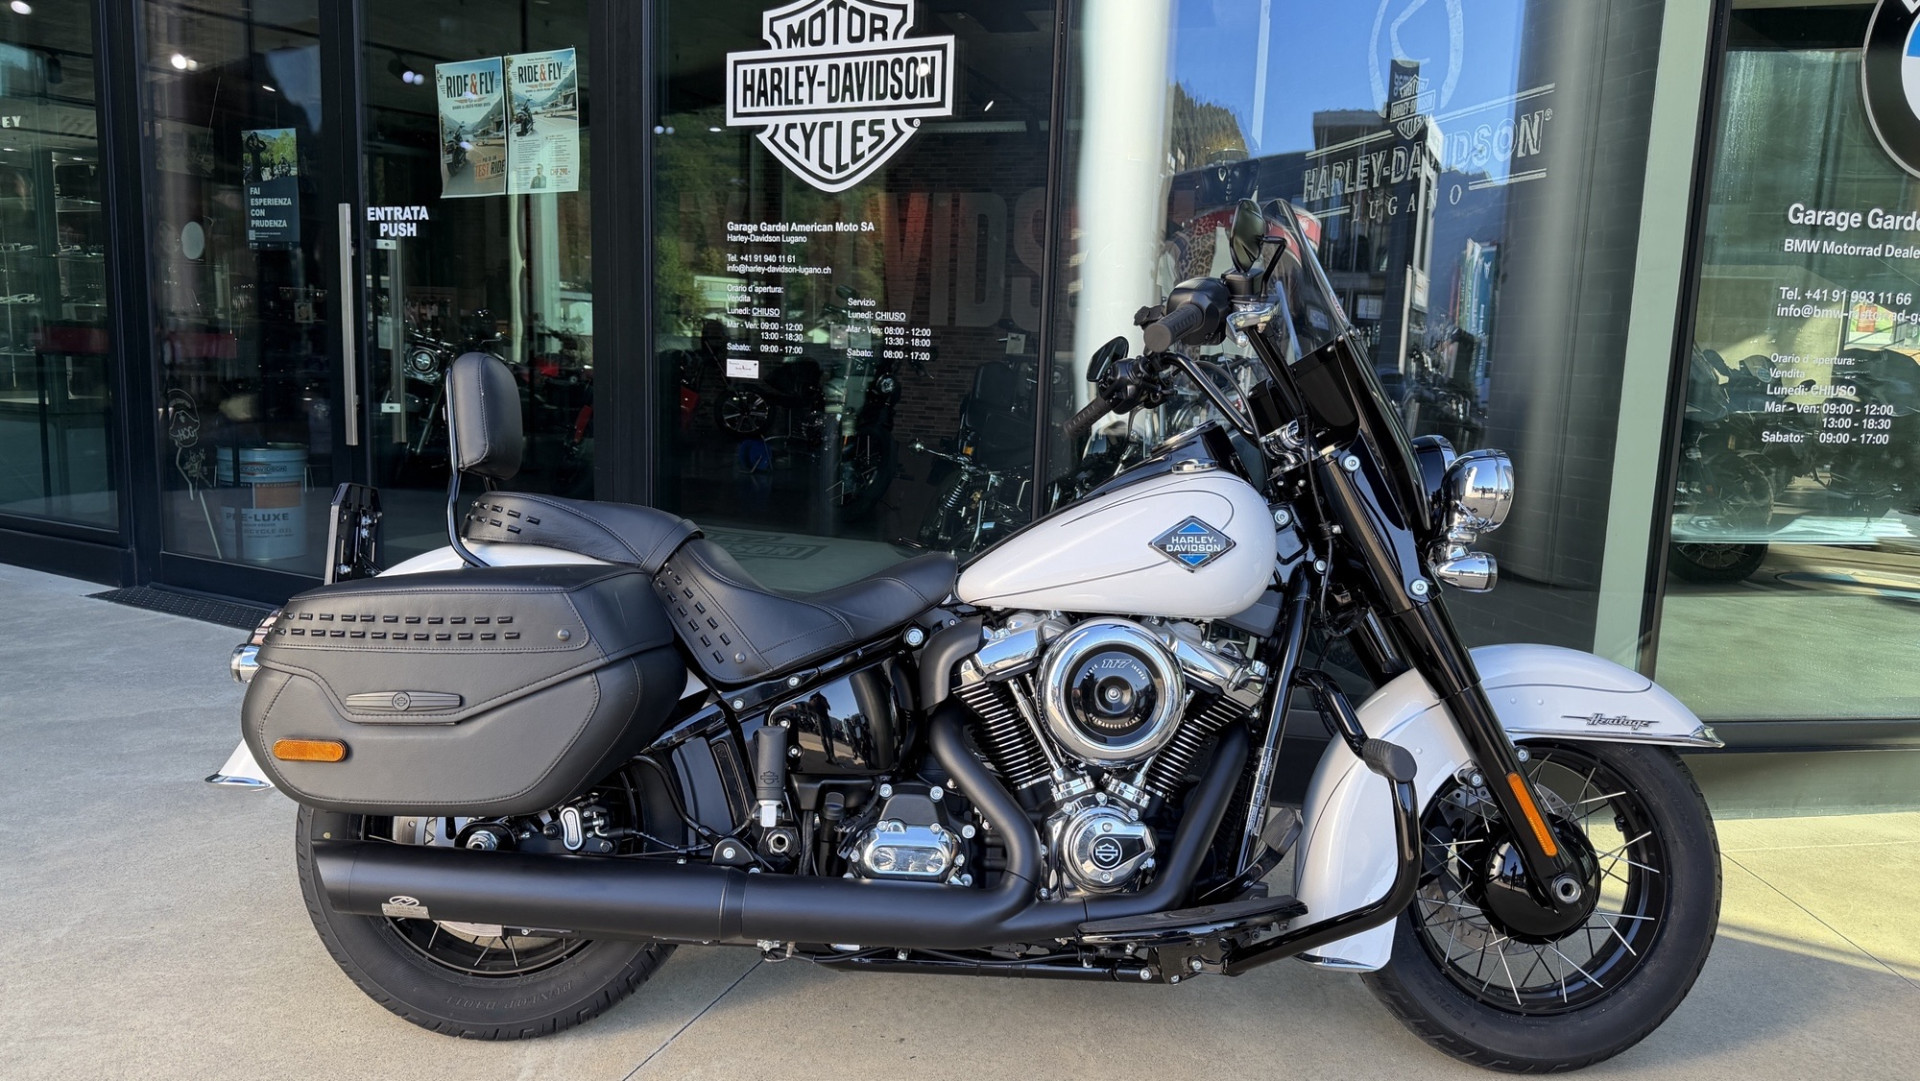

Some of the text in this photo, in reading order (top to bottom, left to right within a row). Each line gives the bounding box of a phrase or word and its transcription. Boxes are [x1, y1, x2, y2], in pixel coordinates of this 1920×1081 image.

[787, 1, 888, 49] MOTOR
[518, 62, 563, 84] RIDE & FLY
[446, 71, 495, 98] RIDE & FLY
[743, 56, 936, 108] HARLEY-DAVIDSON
[785, 118, 885, 175] CYCLES
[249, 187, 261, 195] FAI
[250, 197, 292, 206] ESPERIENZA
[250, 208, 266, 217] CON
[367, 206, 430, 221] ENTRATA
[1788, 203, 1862, 232] Garage
[251, 219, 288, 228] PRUDENZA
[726, 221, 875, 234] Garage Gardel American Moto SA
[380, 222, 417, 237] PUSH
[726, 233, 808, 244] Harley-Davidson Lugano
[1784, 238, 1820, 254] BMW
[1822, 240, 1883, 257] Motorrad
[726, 253, 796, 263] Tel. +41 91 940 11 61
[726, 263, 832, 275] info@harley-davidson-lugano.ch
[727, 284, 747, 293] Orario
[726, 293, 751, 302] Vendita
[1780, 287, 1912, 305] Tel. +41 91 993 11 66
[847, 297, 876, 307] Servizio
[751, 307, 781, 317] CHIUSO
[875, 311, 906, 321] CHIUSO
[760, 322, 780, 330] 09:00
[785, 323, 804, 332] 12:00
[847, 325, 861, 333] Mar
[884, 326, 905, 335] 08:00
[911, 328, 932, 337] 12:00
[761, 332, 780, 341] 13:00
[785, 333, 804, 342] 18:30
[884, 337, 905, 346] 13:30
[911, 338, 931, 347] 18:00
[726, 342, 752, 351] Sabato:
[760, 344, 779, 353] 09:00
[784, 346, 803, 354] 17:00
[846, 348, 874, 357] Sabato:
[883, 350, 904, 359] 08:00
[910, 351, 931, 361] 17:00
[1770, 353, 1801, 364] Orario
[1769, 368, 1805, 378] Vendita
[1810, 385, 1857, 397] CHIUSO
[1764, 401, 1787, 413] Mar
[1796, 403, 1820, 414] Ven:
[1822, 403, 1854, 415] 09:00
[1864, 404, 1894, 416] 12:00
[1822, 417, 1852, 429] 13:00
[1862, 418, 1892, 430] 18:30
[1761, 431, 1805, 443] Sabato:
[1819, 432, 1850, 444] 09:00
[1860, 433, 1890, 445] 17:00
[226, 512, 289, 522] PE-LUXE
[1171, 536, 1217, 544] HARLEY-
[1166, 544, 1221, 552] DAVIDSON
[1101, 658, 1132, 669] 117
[1575, 713, 1654, 731] Heritage
